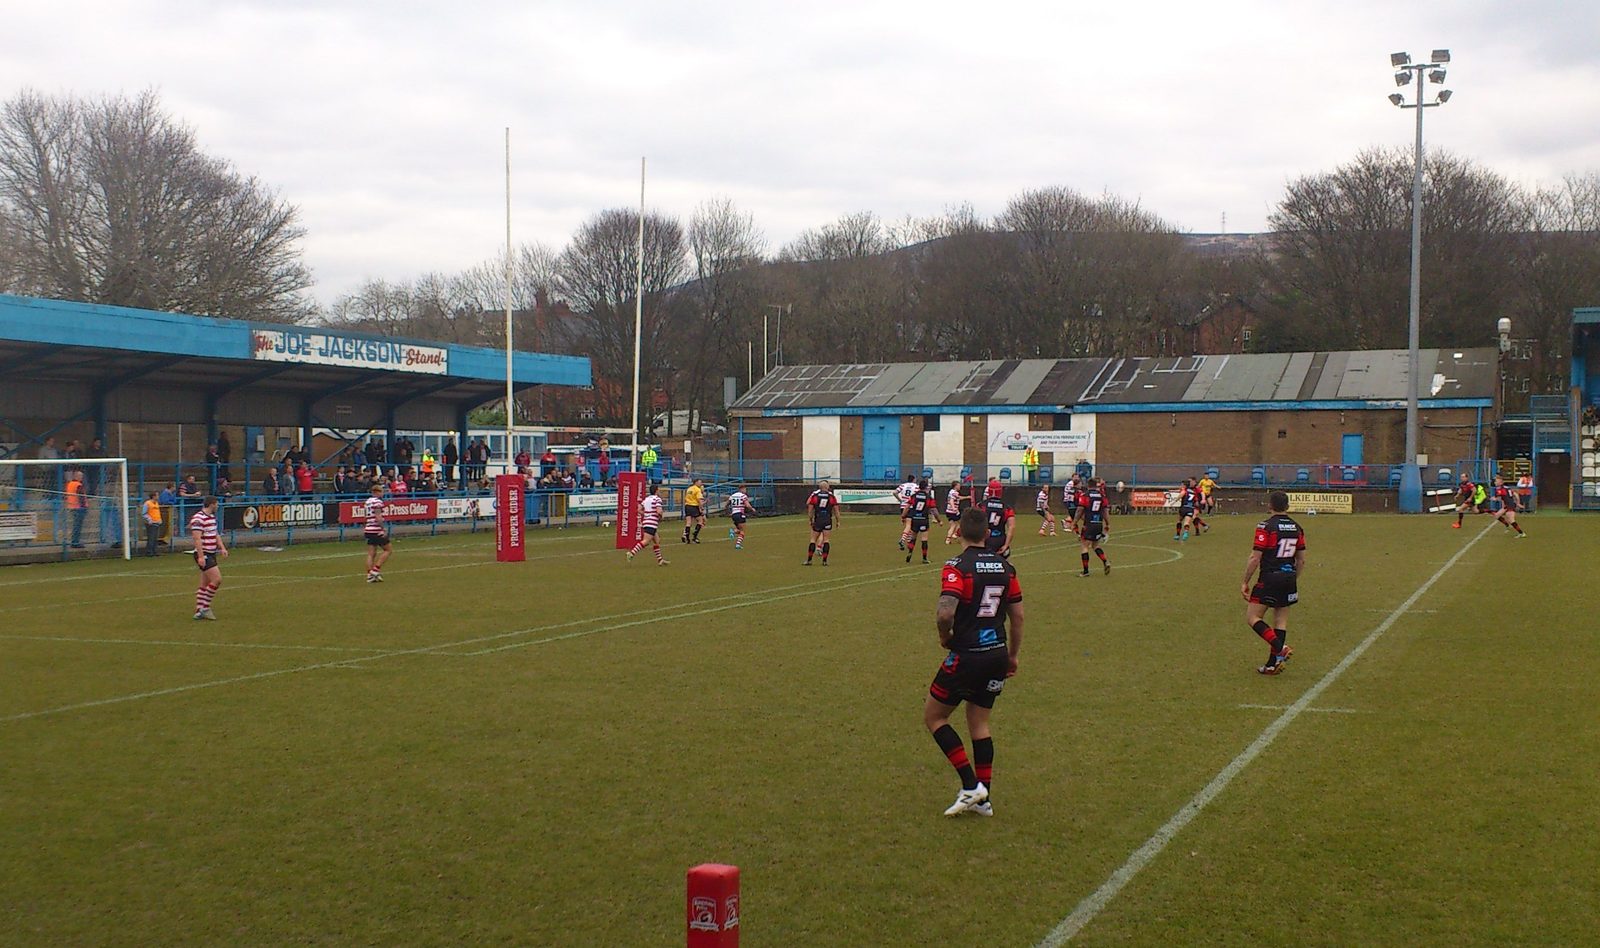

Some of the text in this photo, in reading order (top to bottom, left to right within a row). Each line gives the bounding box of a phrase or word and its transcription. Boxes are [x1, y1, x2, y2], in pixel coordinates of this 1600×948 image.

[255, 332, 443, 367] The JOE JACKSON Stand
[1091, 500, 1101, 512] 6
[1187, 493, 1195, 501] 7
[1313, 494, 1350, 503] LIMITED
[258, 503, 323, 522] vanarama
[390, 503, 409, 516] Press
[410, 502, 428, 514] Cider
[509, 489, 519, 547] PROPER CIDER
[621, 508, 629, 537] PROPER
[1276, 538, 1298, 558] 15
[976, 586, 1005, 618] 5
